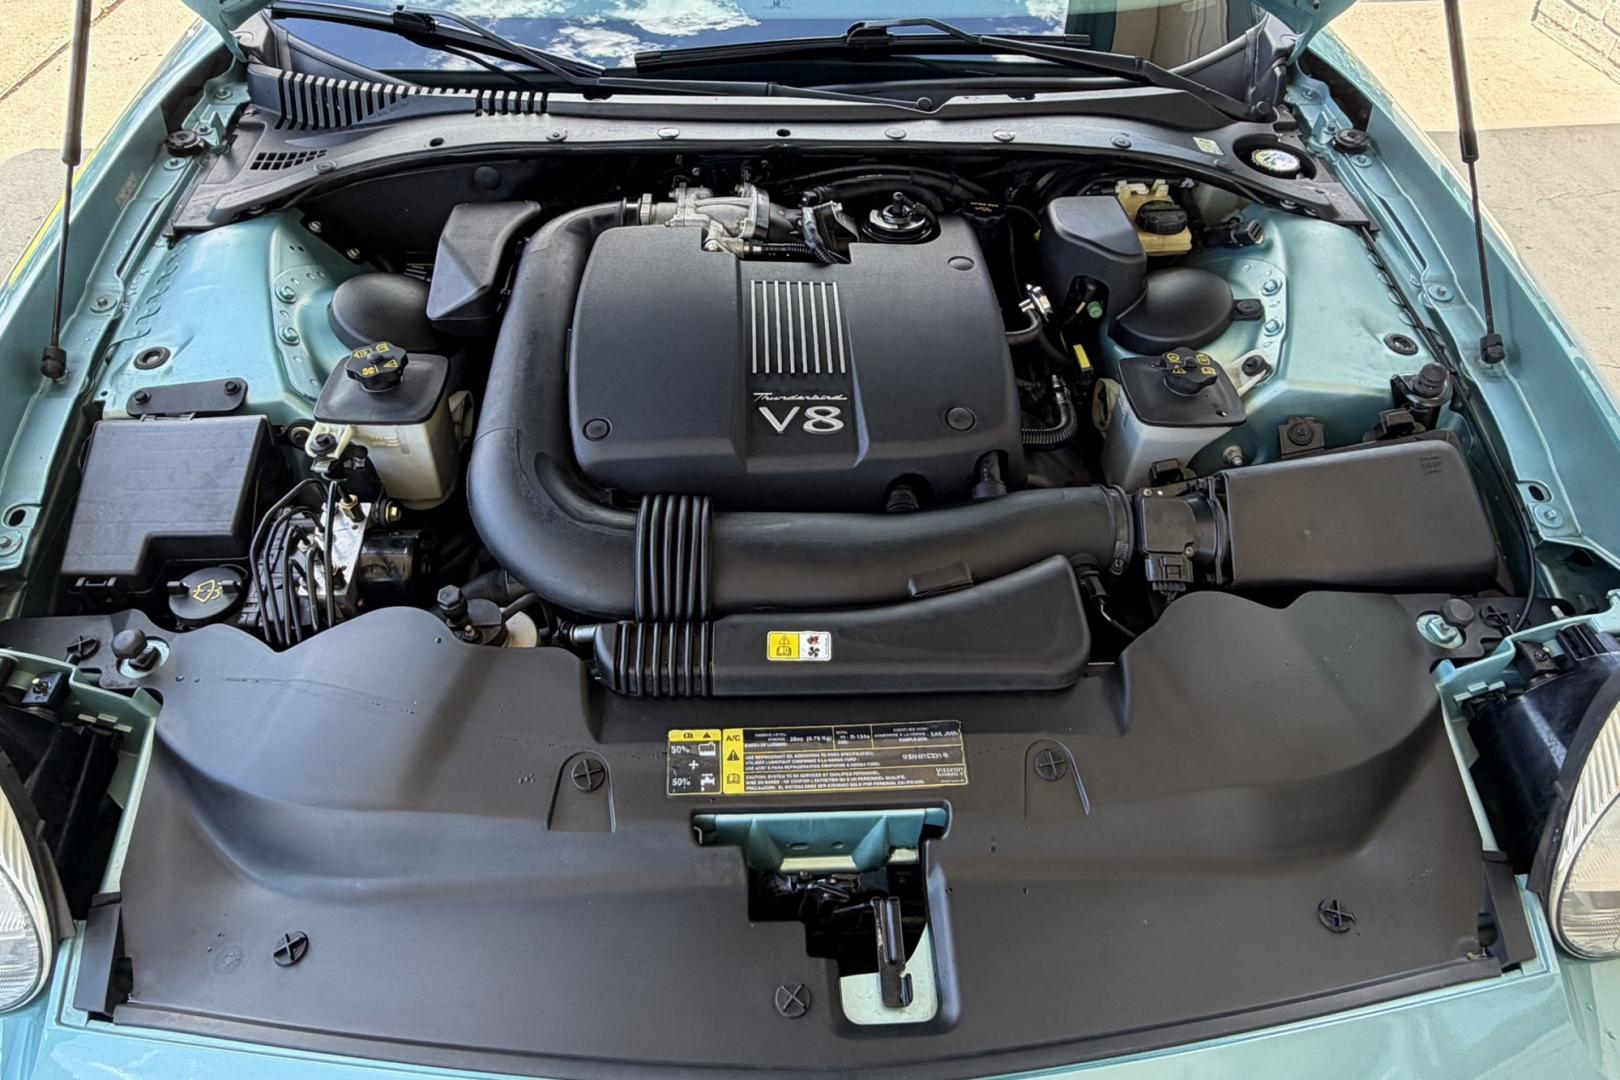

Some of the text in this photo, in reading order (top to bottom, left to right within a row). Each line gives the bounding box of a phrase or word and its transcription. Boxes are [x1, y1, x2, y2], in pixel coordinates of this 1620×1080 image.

[753, 392, 848, 402] Thunderbird
[758, 405, 845, 434] V8
[671, 745, 690, 754] 50%
[672, 777, 691, 786] 50%
